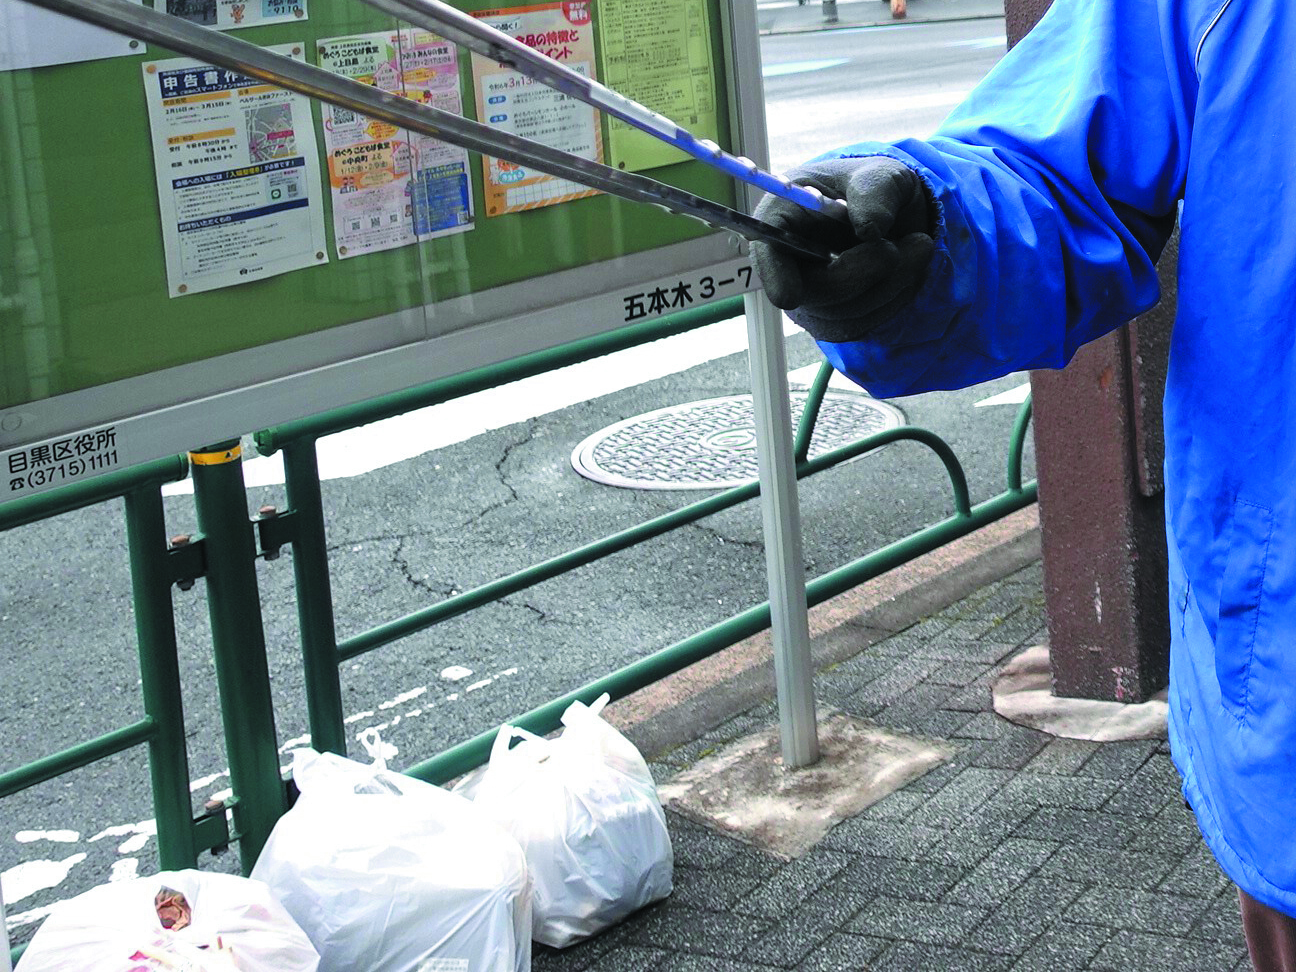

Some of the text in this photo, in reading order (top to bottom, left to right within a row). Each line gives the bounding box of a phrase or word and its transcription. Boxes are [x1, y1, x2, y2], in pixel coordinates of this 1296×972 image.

[8, 427, 117, 474] 目黒区役所
